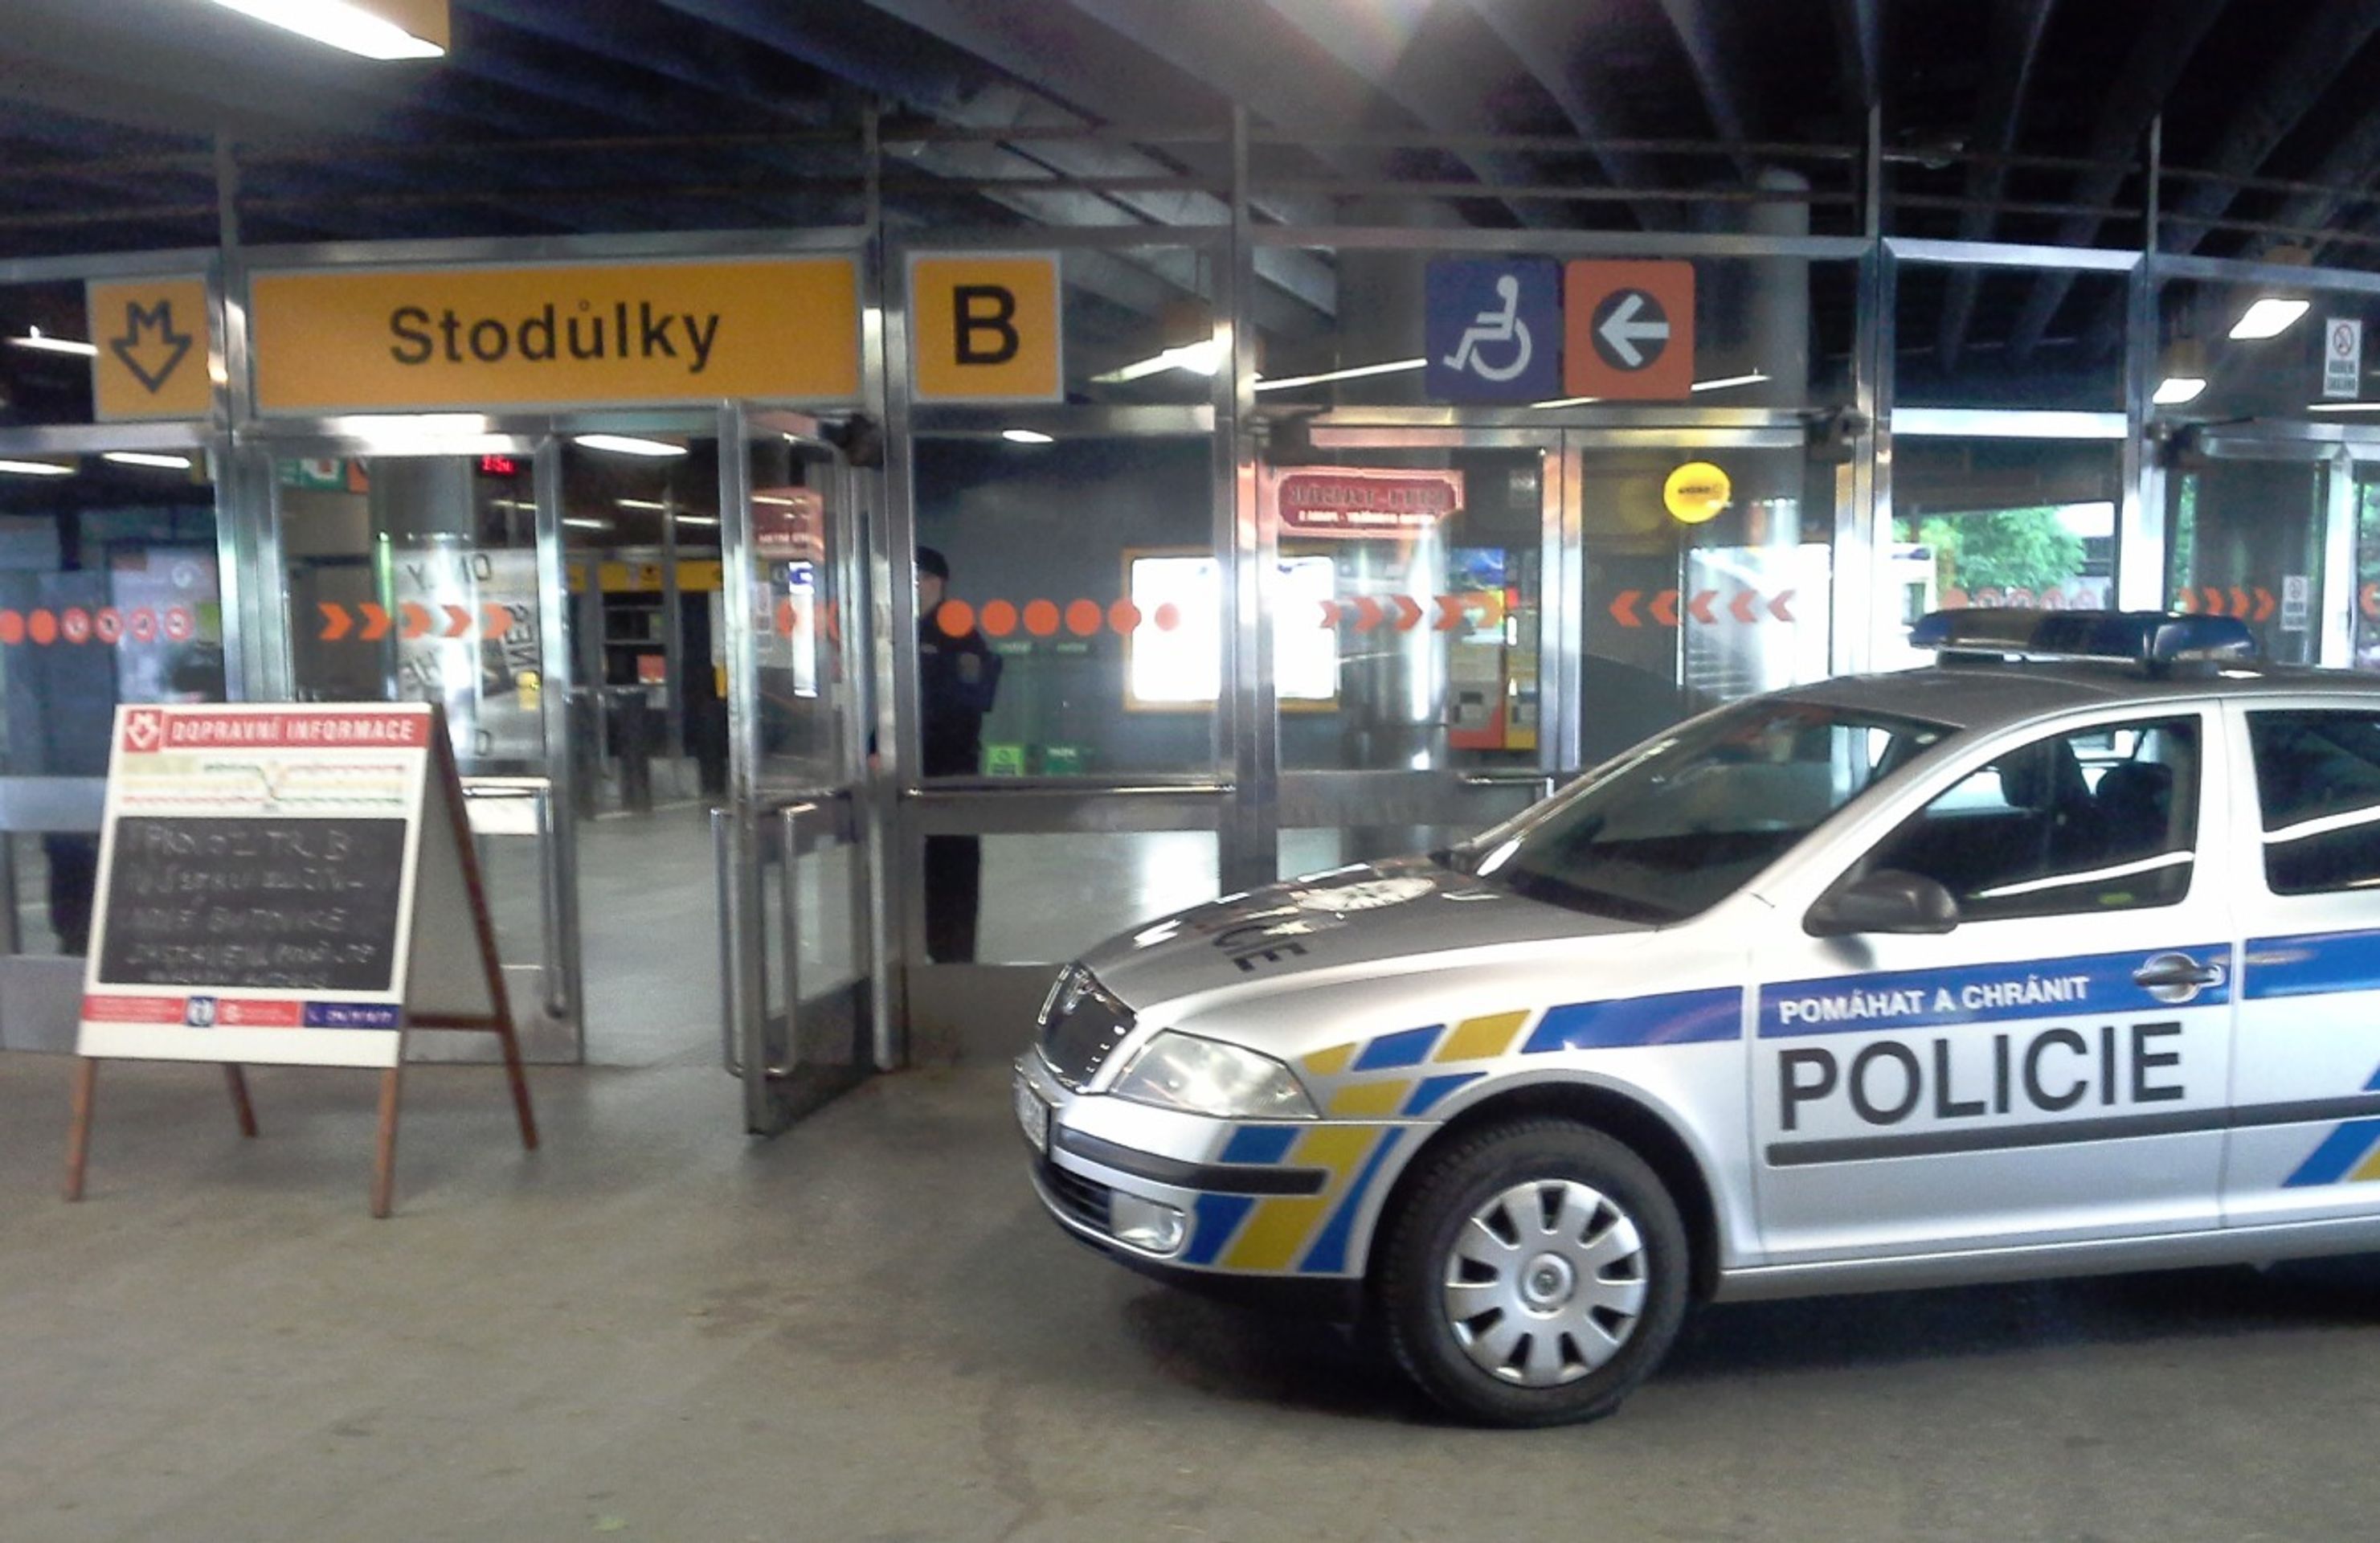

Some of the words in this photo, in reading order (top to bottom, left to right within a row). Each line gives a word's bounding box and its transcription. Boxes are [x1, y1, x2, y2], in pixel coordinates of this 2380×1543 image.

[389, 300, 720, 374] Stodůlky
[952, 284, 1020, 366] B
[171, 716, 280, 741] DOPRAVNÍ
[285, 718, 414, 741] INFORMACE
[1778, 989, 1925, 1025] POMÁHAT
[1932, 987, 1957, 1013] A
[1961, 974, 2091, 1009] CHRÁNIT
[1777, 1021, 2185, 1132] POLICIE
